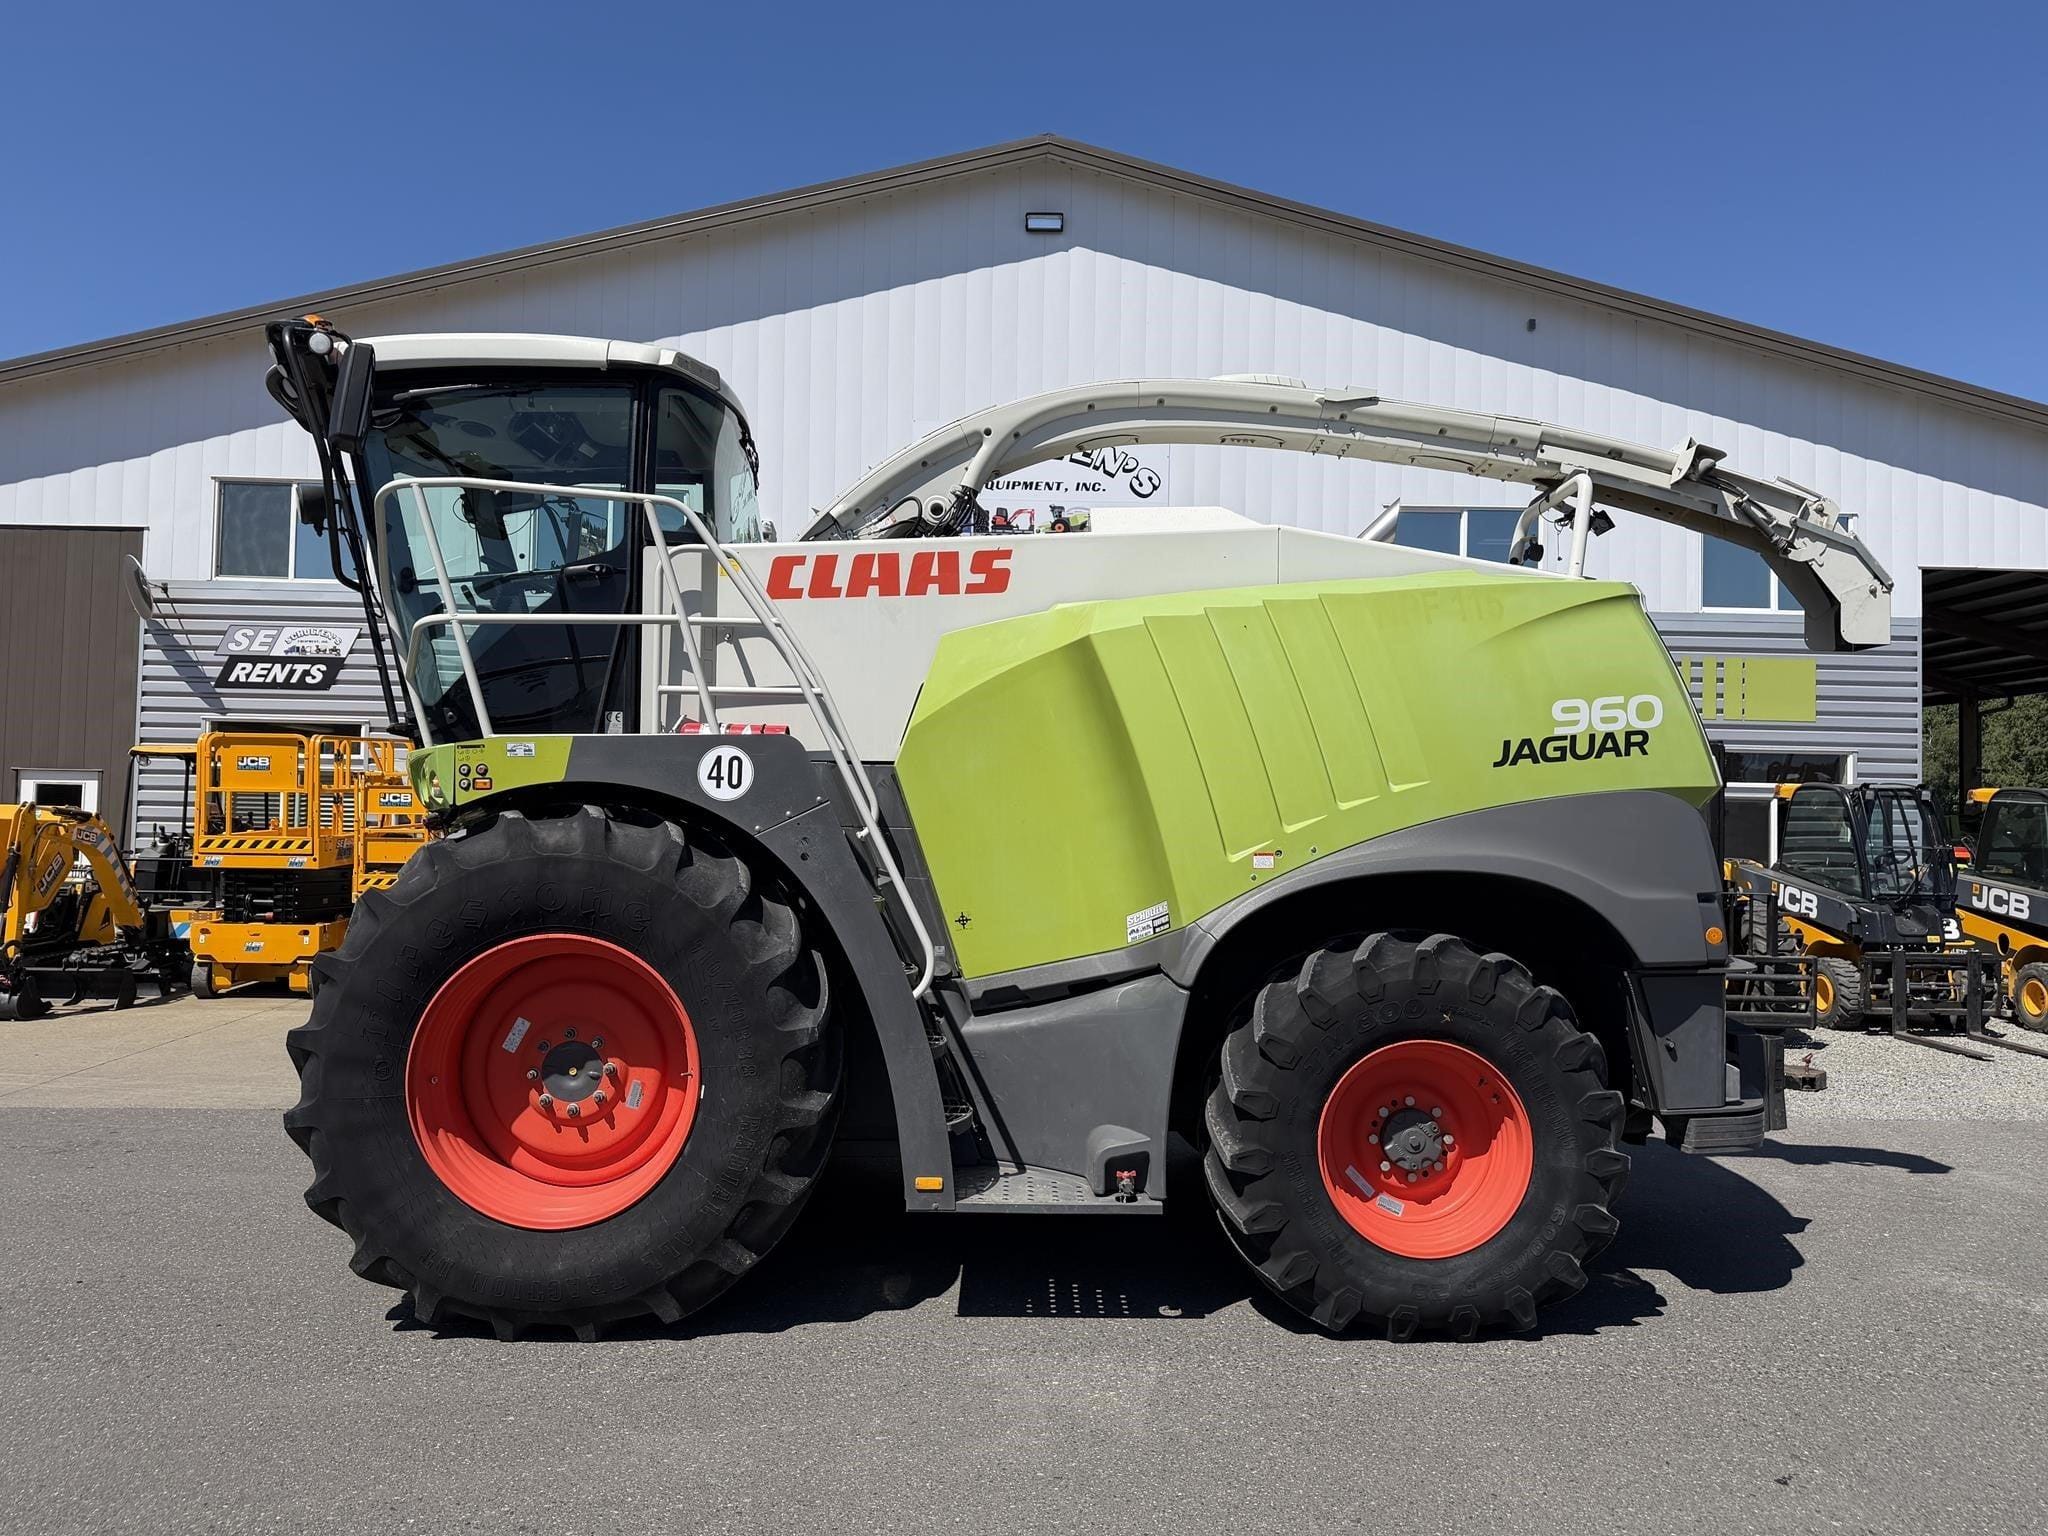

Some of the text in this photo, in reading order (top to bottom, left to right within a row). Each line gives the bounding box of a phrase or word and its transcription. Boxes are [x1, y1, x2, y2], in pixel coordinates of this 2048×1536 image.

[985, 480, 1107, 493] QUIPMENT, INC.
[766, 548, 1014, 600] CLAAS
[227, 628, 279, 652] SE
[227, 661, 328, 684] RENTS
[1551, 694, 1664, 735] 960
[237, 756, 270, 766] JCB
[1492, 730, 1650, 768] JAGUAR
[706, 755, 744, 790] 40
[379, 793, 412, 803] JCB
[77, 829, 98, 842] JCB
[39, 854, 63, 893] JCB
[1777, 883, 1818, 919] JCB
[1971, 884, 2031, 921] JCB
